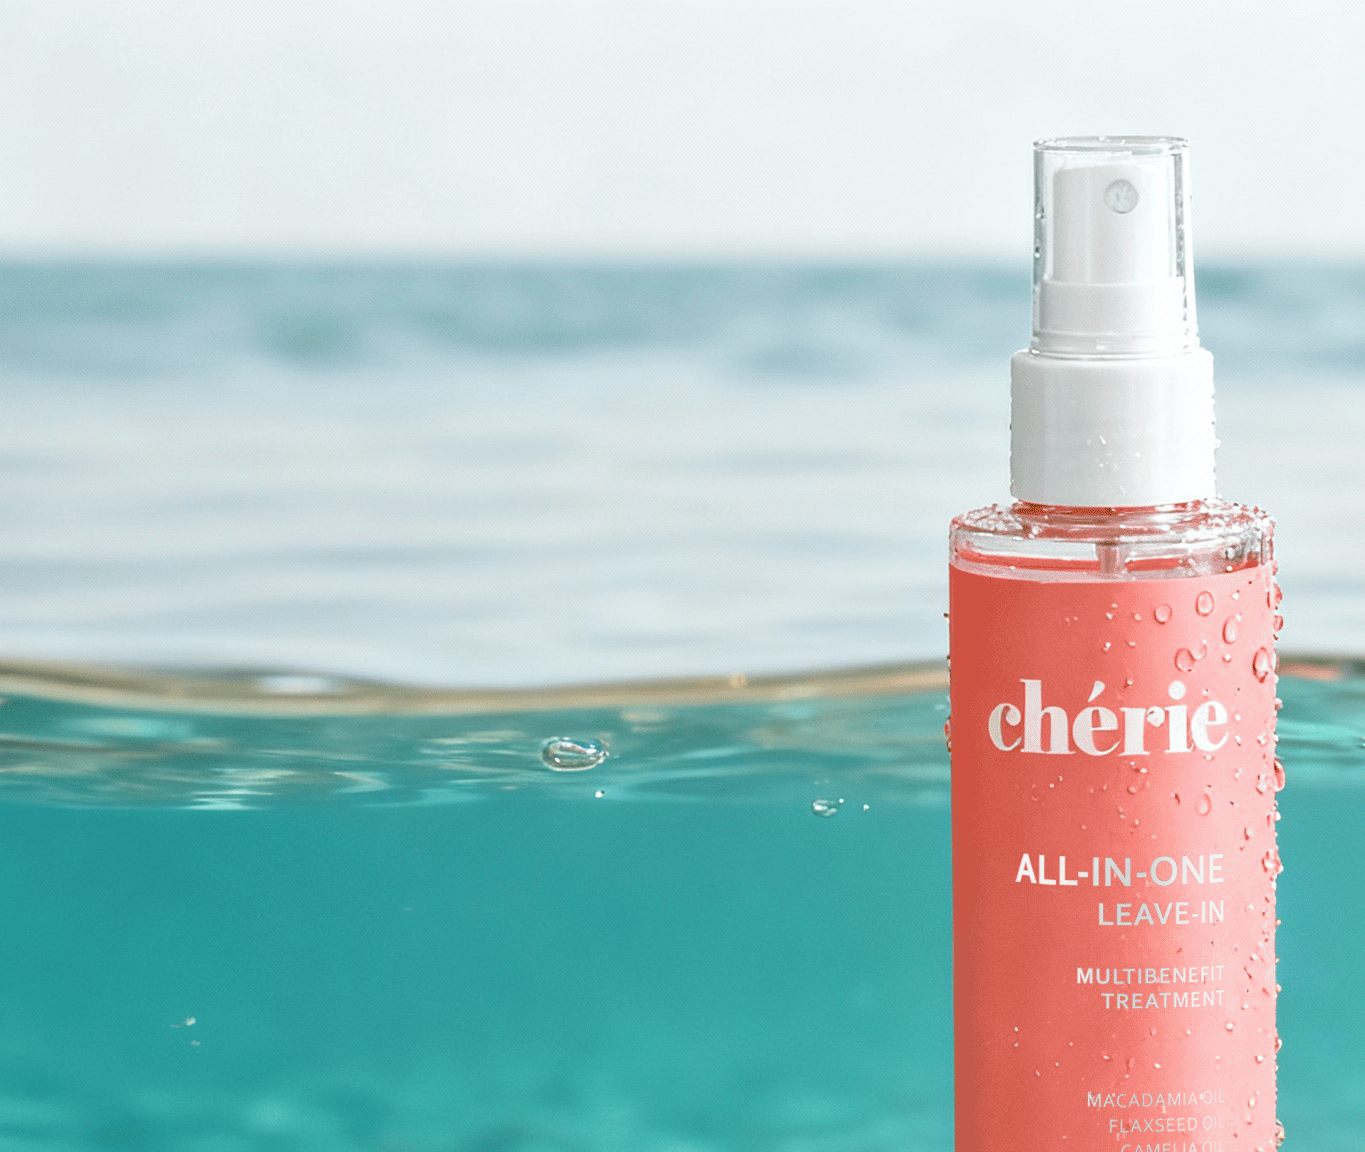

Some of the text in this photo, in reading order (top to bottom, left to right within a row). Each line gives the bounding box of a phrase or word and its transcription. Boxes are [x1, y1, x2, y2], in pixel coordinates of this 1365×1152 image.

[988, 679, 1229, 756] chérie
[1016, 853, 1224, 887] ALL-IN-ONE
[1098, 900, 1224, 926] LEAVE-IN
[1076, 965, 1225, 985] MULTIBENEFIT
[1101, 990, 1225, 1009] TREATMENT
[1087, 1090, 1225, 1108] MACADAMIA OIL
[1109, 1115, 1225, 1133] FLAXSEED OIL
